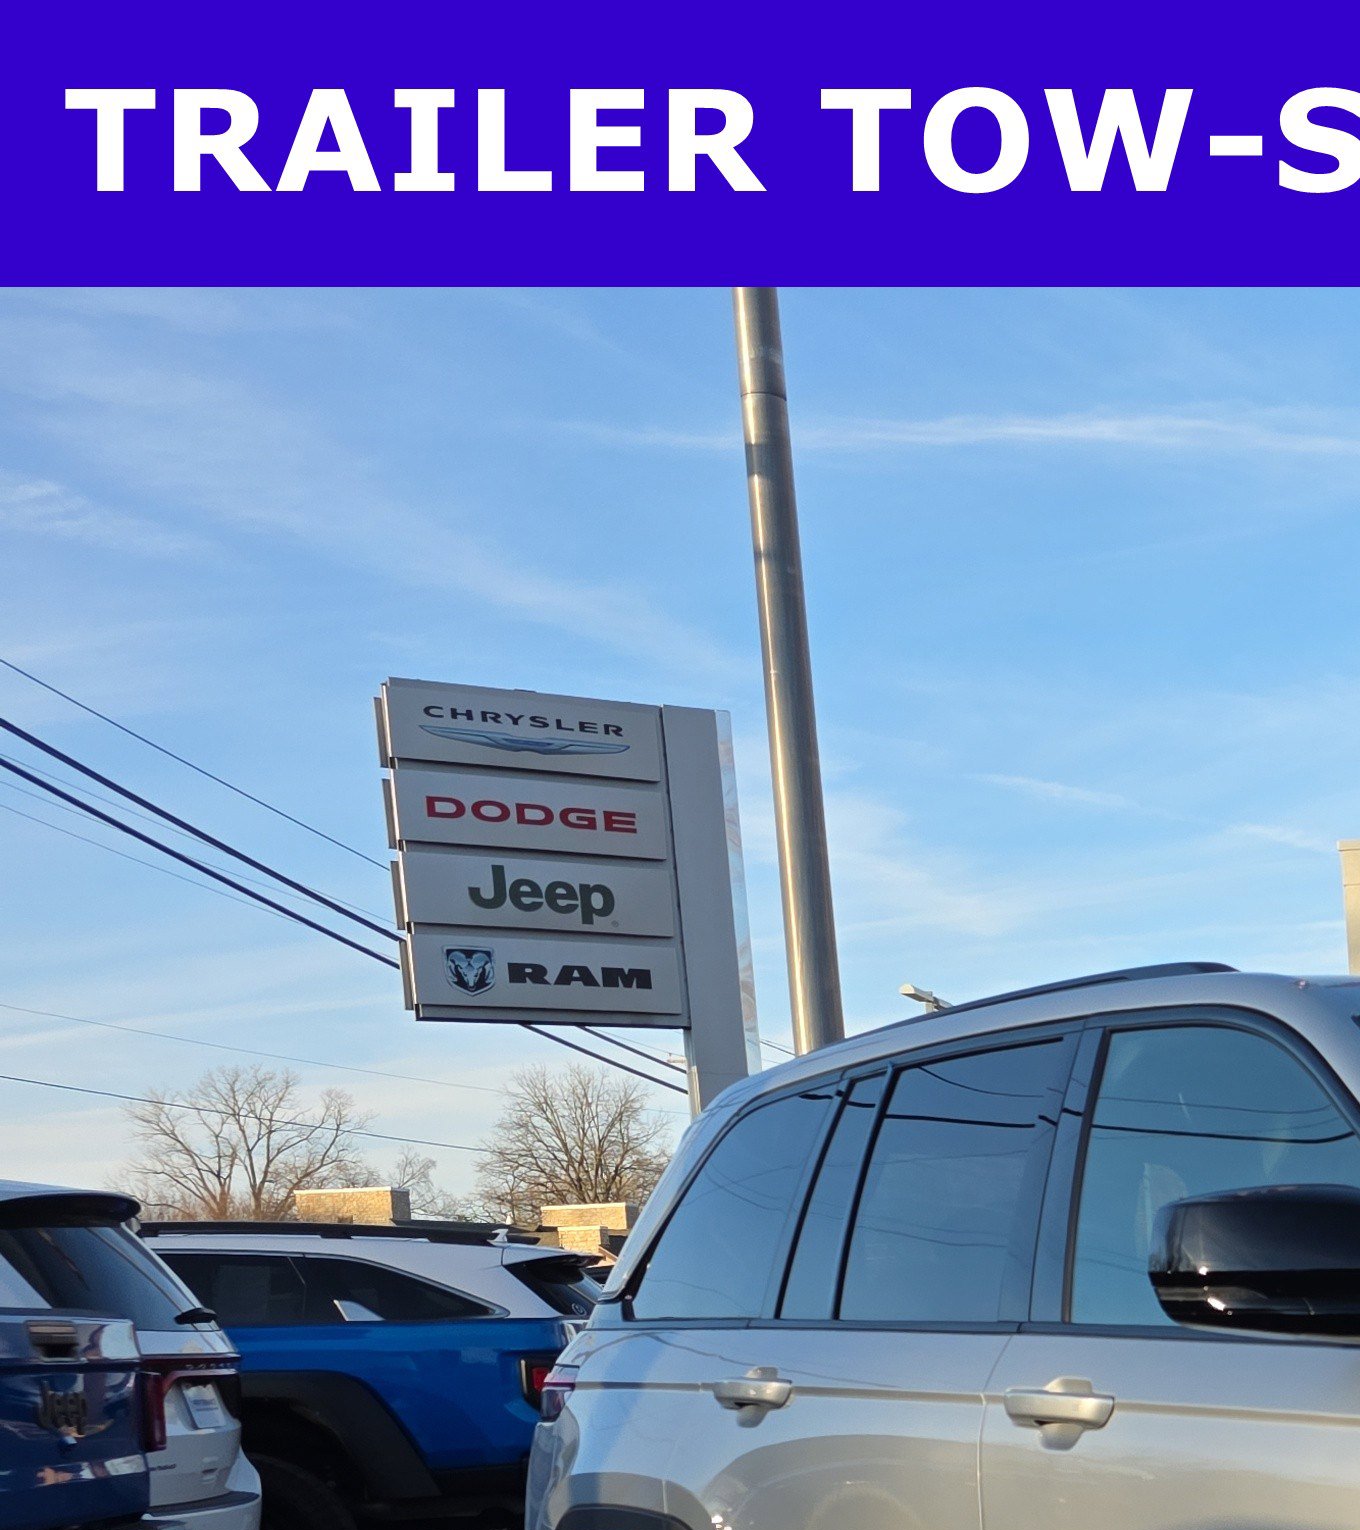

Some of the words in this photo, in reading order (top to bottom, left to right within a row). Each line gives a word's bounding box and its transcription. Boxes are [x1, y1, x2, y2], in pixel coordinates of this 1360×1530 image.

[423, 705, 626, 738] CHRYSLER
[425, 795, 638, 835] DODGE
[467, 864, 616, 926] Jeep
[506, 961, 653, 990] RAM
